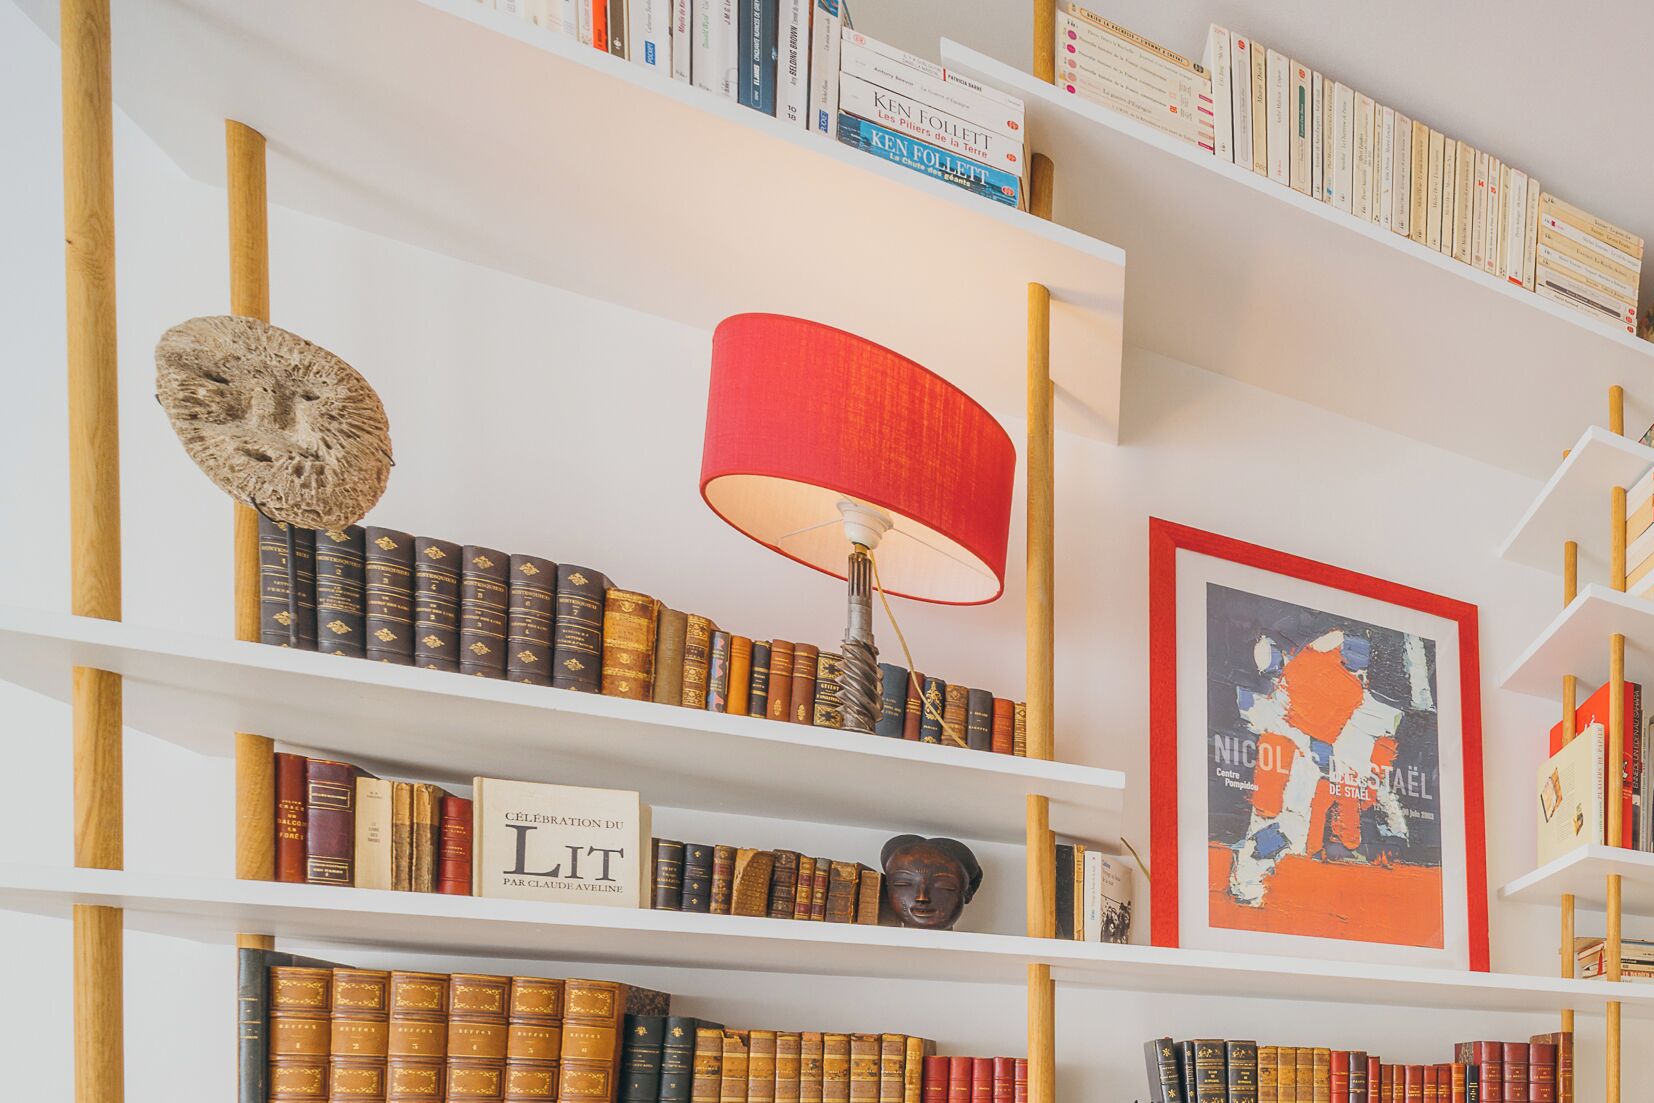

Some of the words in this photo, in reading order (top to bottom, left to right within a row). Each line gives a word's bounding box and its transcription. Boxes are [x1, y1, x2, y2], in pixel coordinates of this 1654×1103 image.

[790, 25, 799, 49] BROWN
[789, 50, 798, 76] BELDING
[787, 104, 797, 113] 10
[787, 113, 797, 121] 18
[874, 91, 911, 118] KEN
[920, 109, 993, 150] FOLLETT
[878, 109, 896, 124] Les
[900, 116, 931, 137] Piliers
[934, 130, 948, 142] de
[950, 136, 960, 148] la
[963, 142, 988, 159] Terre
[871, 130, 908, 157] KEN
[913, 145, 990, 186] FOLLETT
[889, 152, 900, 162] La
[902, 156, 926, 171] Chute
[927, 165, 943, 177] des
[944, 172, 971, 188] géants
[1216, 767, 1240, 780] Centre
[1368, 765, 1433, 800] STAËL
[1224, 778, 1259, 792] Pompidou
[1329, 784, 1342, 795] DE
[1344, 786, 1371, 801] STAËL
[505, 811, 601, 829] CÉLÉBRATION
[605, 820, 624, 831] DU
[279, 831, 304, 841] FORÊT
[503, 824, 624, 882] LIT
[503, 878, 526, 887] PAR
[528, 880, 575, 890] CLAUDE
[575, 884, 623, 893] AVELINE
